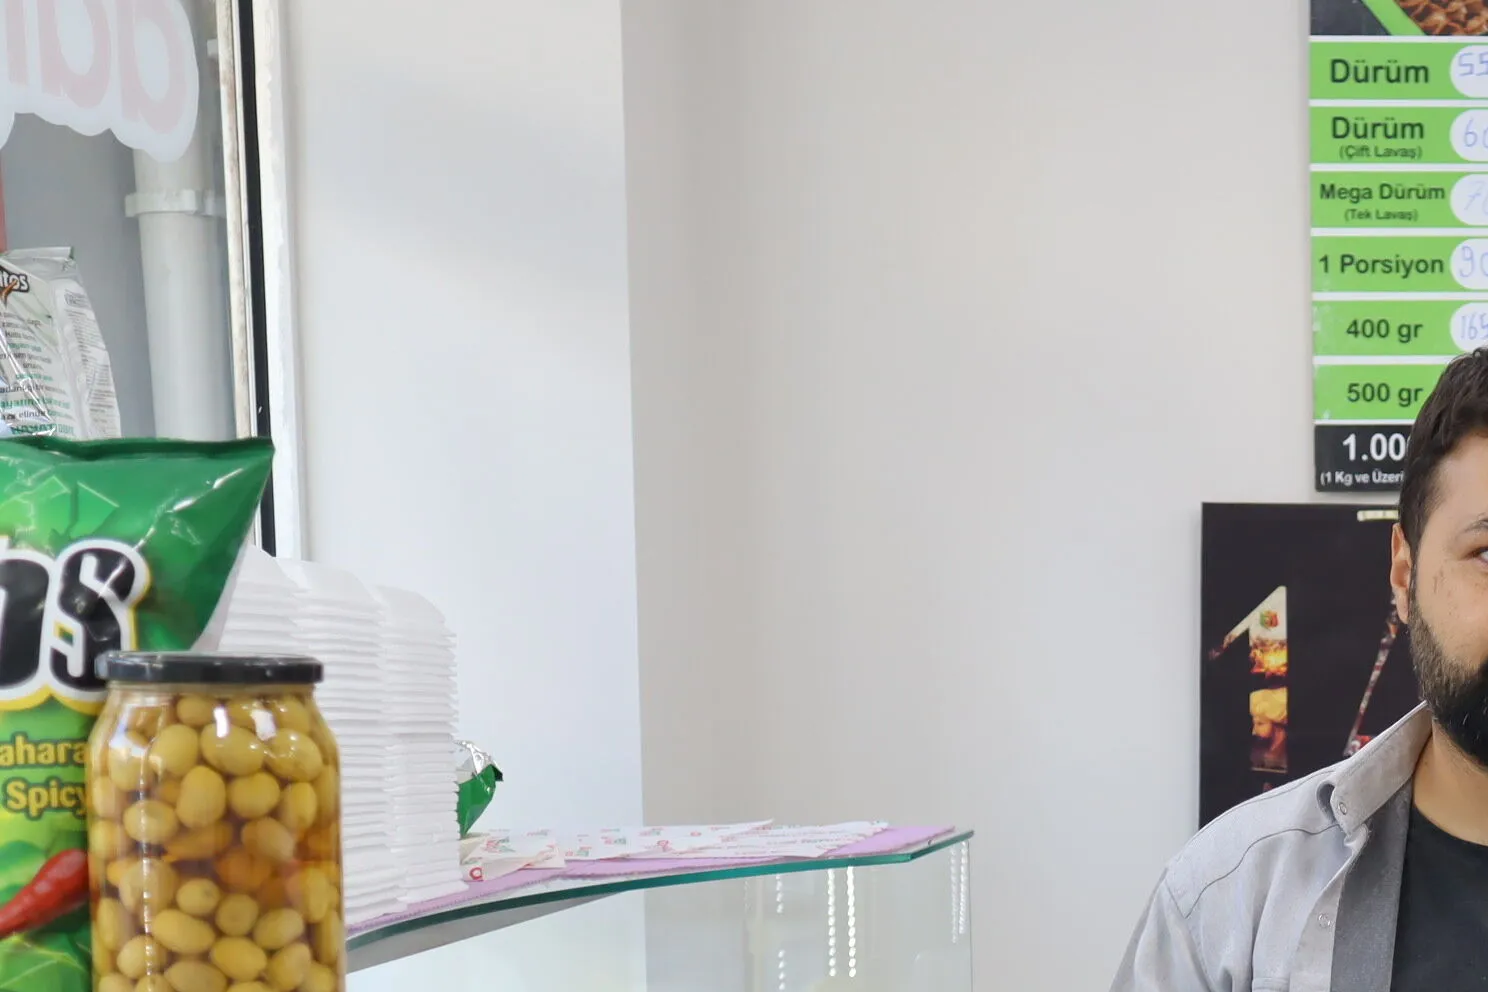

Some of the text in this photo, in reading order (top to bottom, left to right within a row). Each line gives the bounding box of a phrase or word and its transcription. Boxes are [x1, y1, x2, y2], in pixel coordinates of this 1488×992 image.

[1330, 59, 1430, 84] Dürüm
[1332, 116, 1425, 139] Dürüm
[1319, 183, 1445, 204] Mega Dürüm
[1319, 253, 1444, 279] 1 Porsiyon
[1346, 319, 1423, 344] 400 gr
[1347, 382, 1424, 408] 500 gr
[1342, 432, 1409, 462] 1.00
[1335, 471, 1352, 487] Kg
[1355, 474, 1370, 484] ve
